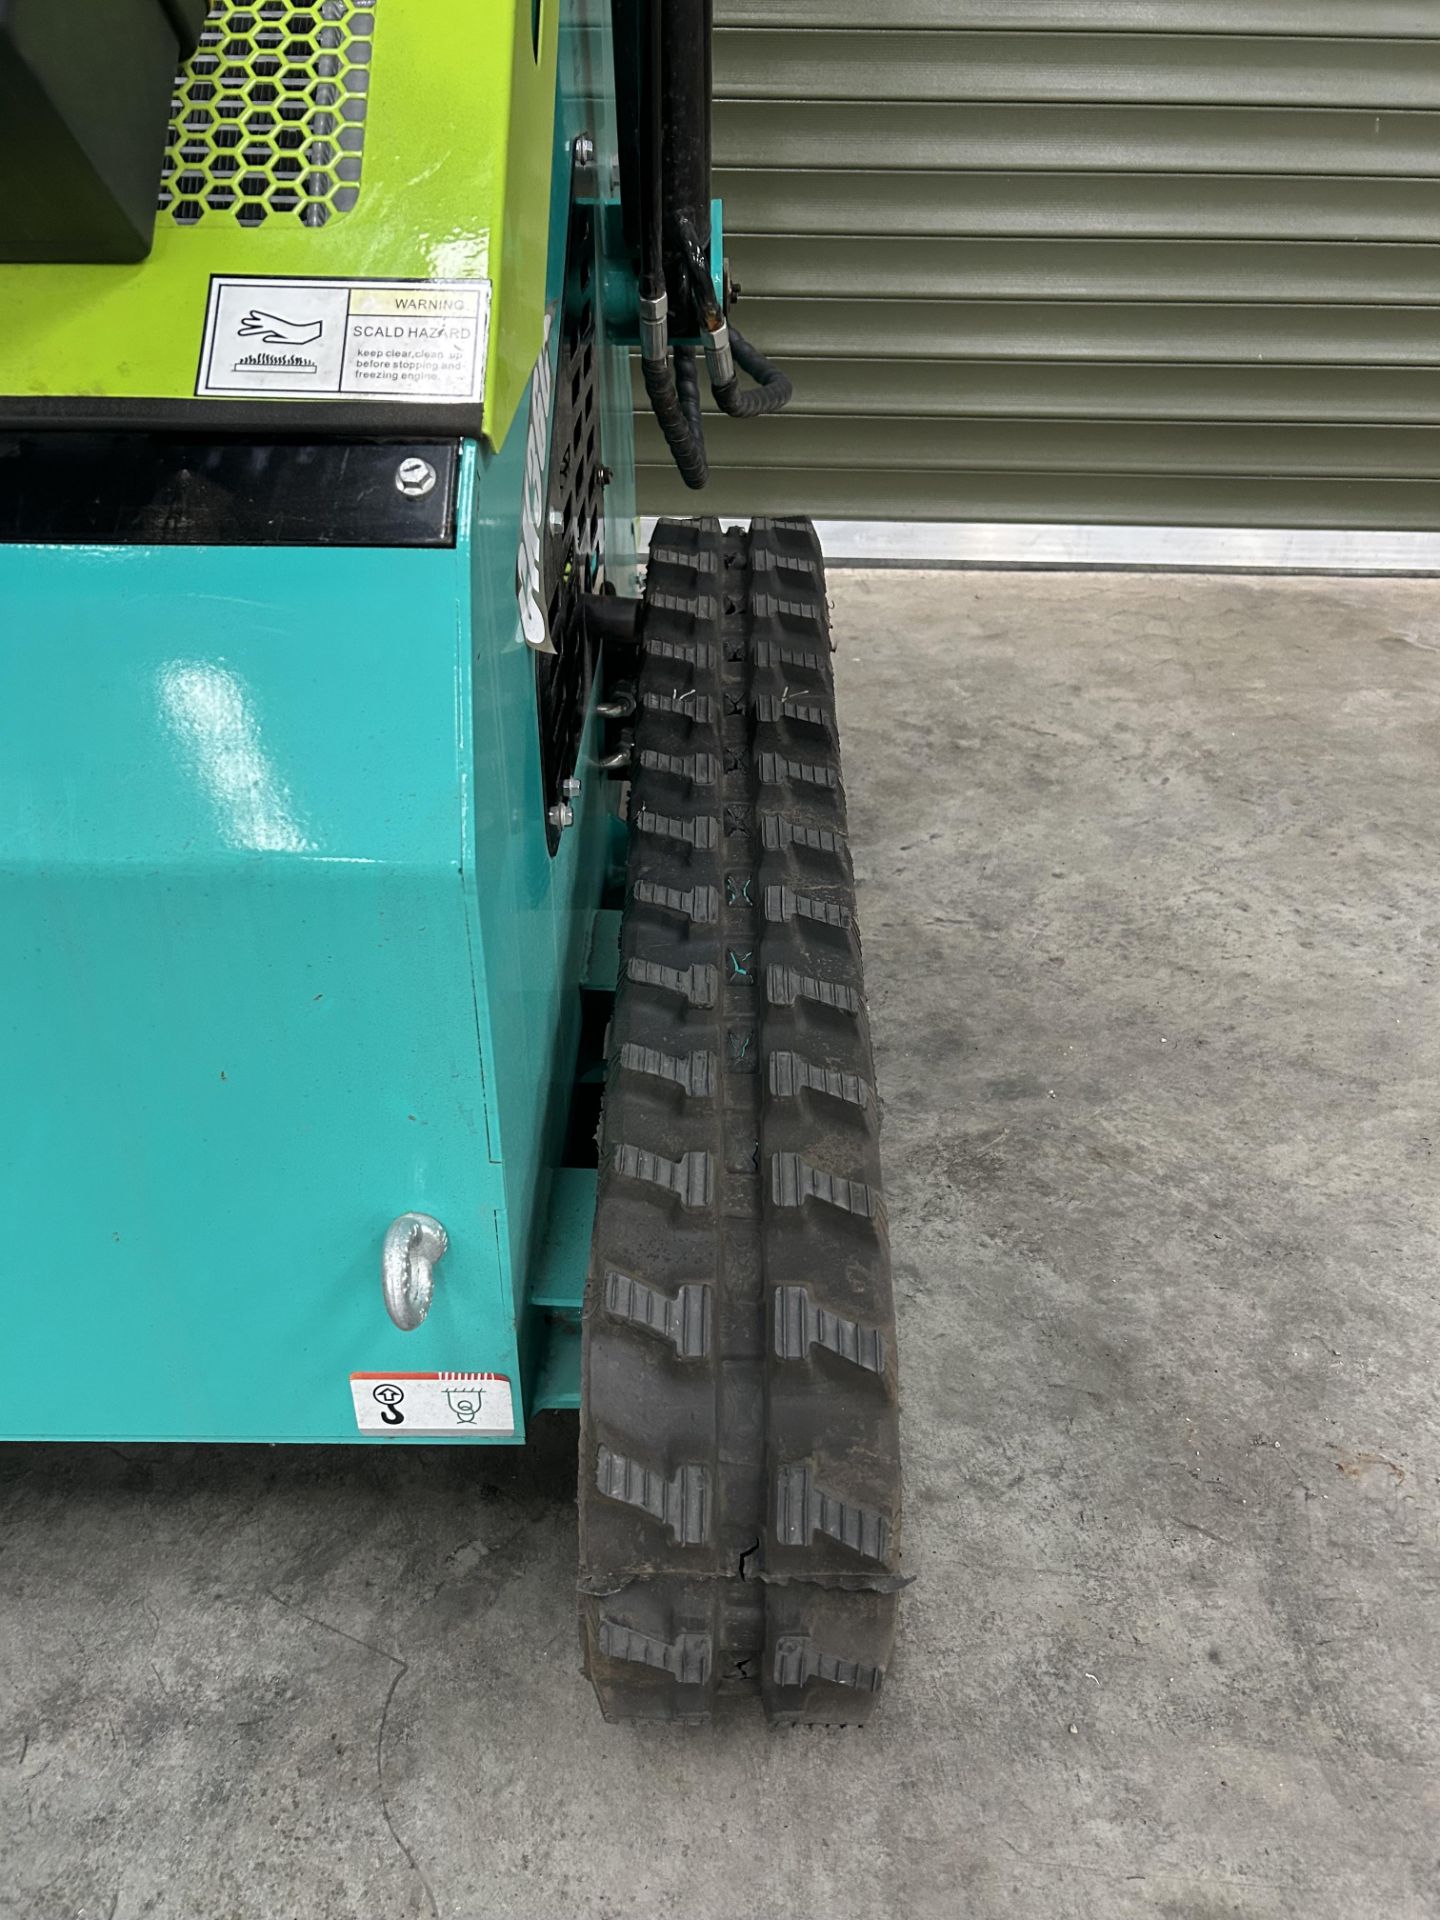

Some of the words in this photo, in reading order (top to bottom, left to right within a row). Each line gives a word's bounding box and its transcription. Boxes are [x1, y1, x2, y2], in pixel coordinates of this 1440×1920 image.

[394, 298, 465, 311] WARNING
[353, 326, 404, 338] SCALD
[408, 327, 471, 339] HAZARD
[356, 360, 391, 368] before
[393, 360, 439, 371] stopping
[441, 361, 462, 370] and
[355, 369, 399, 381] freezing
